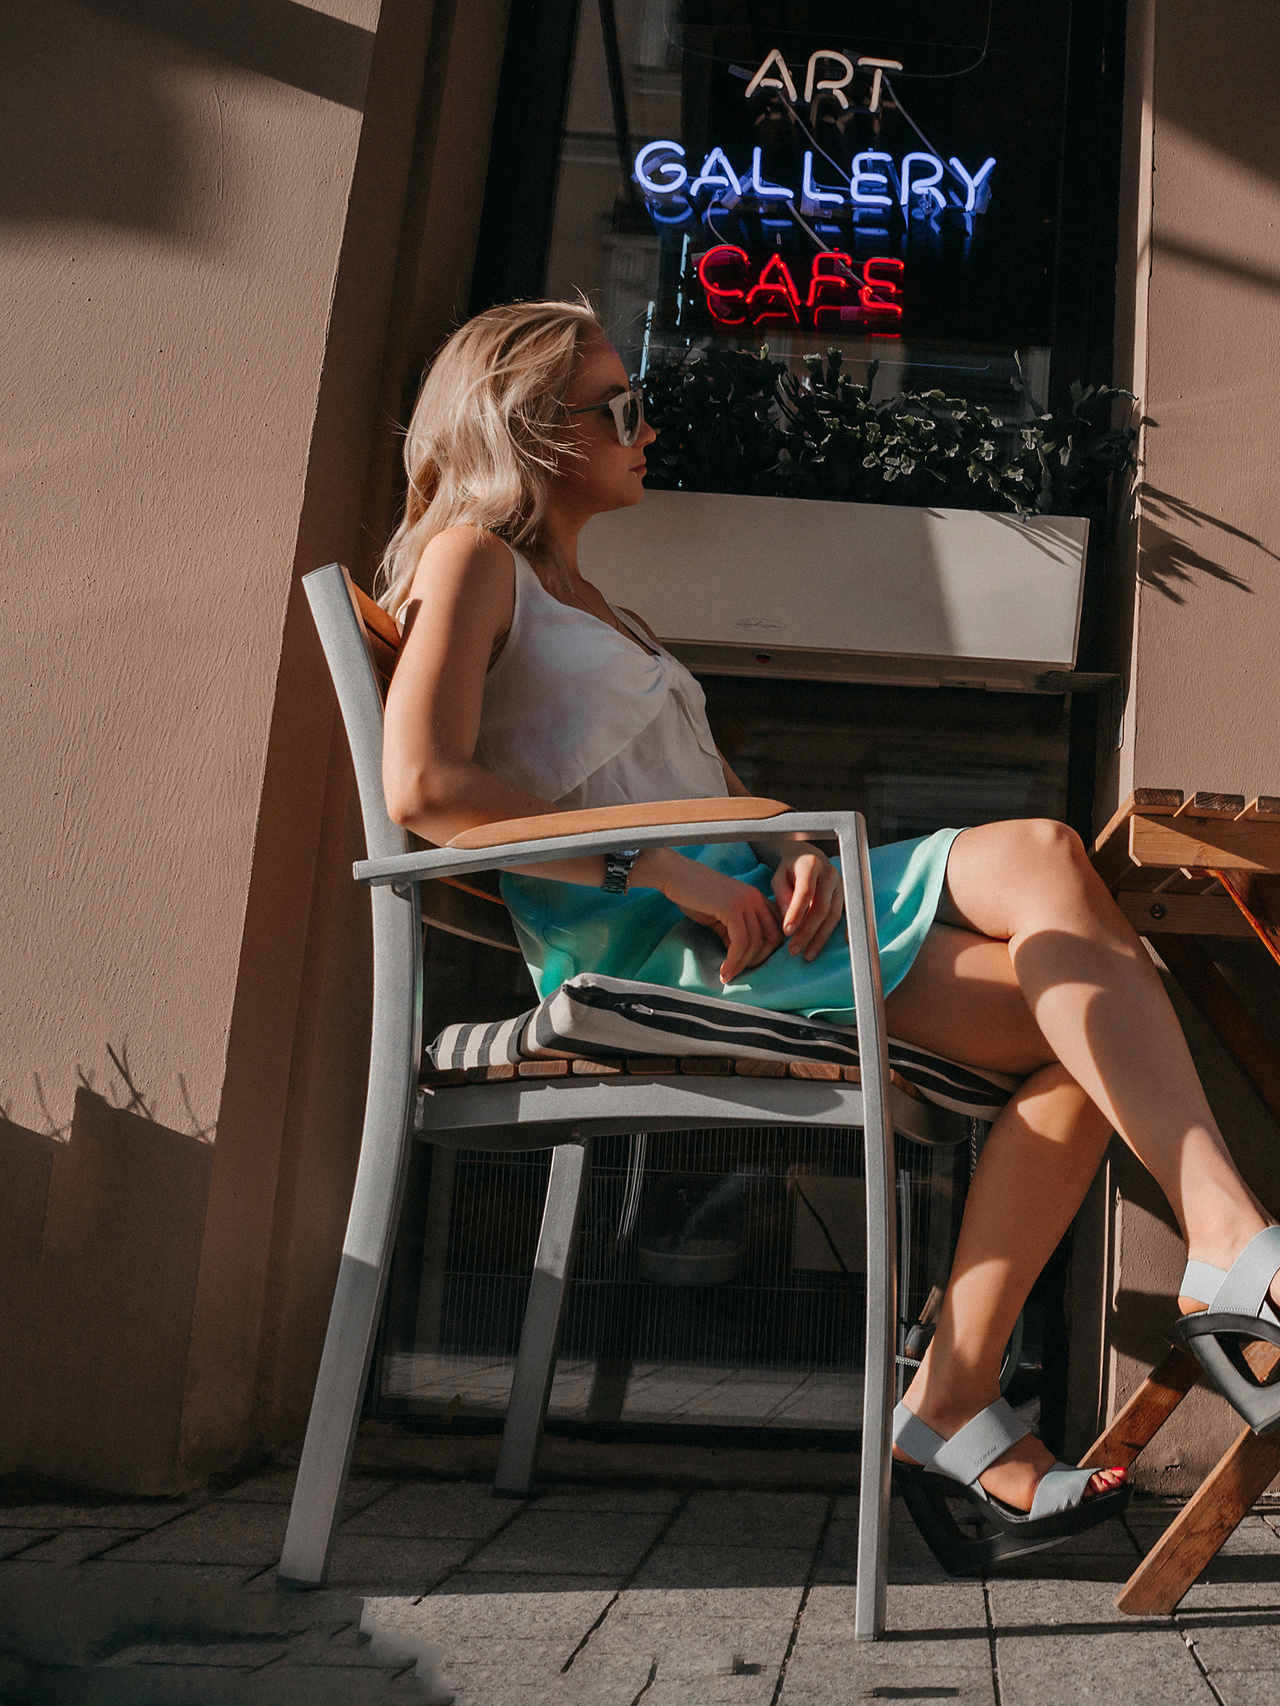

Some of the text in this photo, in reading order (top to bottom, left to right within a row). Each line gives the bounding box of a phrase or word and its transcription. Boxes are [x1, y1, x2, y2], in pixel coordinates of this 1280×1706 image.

[745, 48, 903, 112] ART
[634, 139, 996, 212] GALLERY
[699, 244, 905, 315] CAFE
